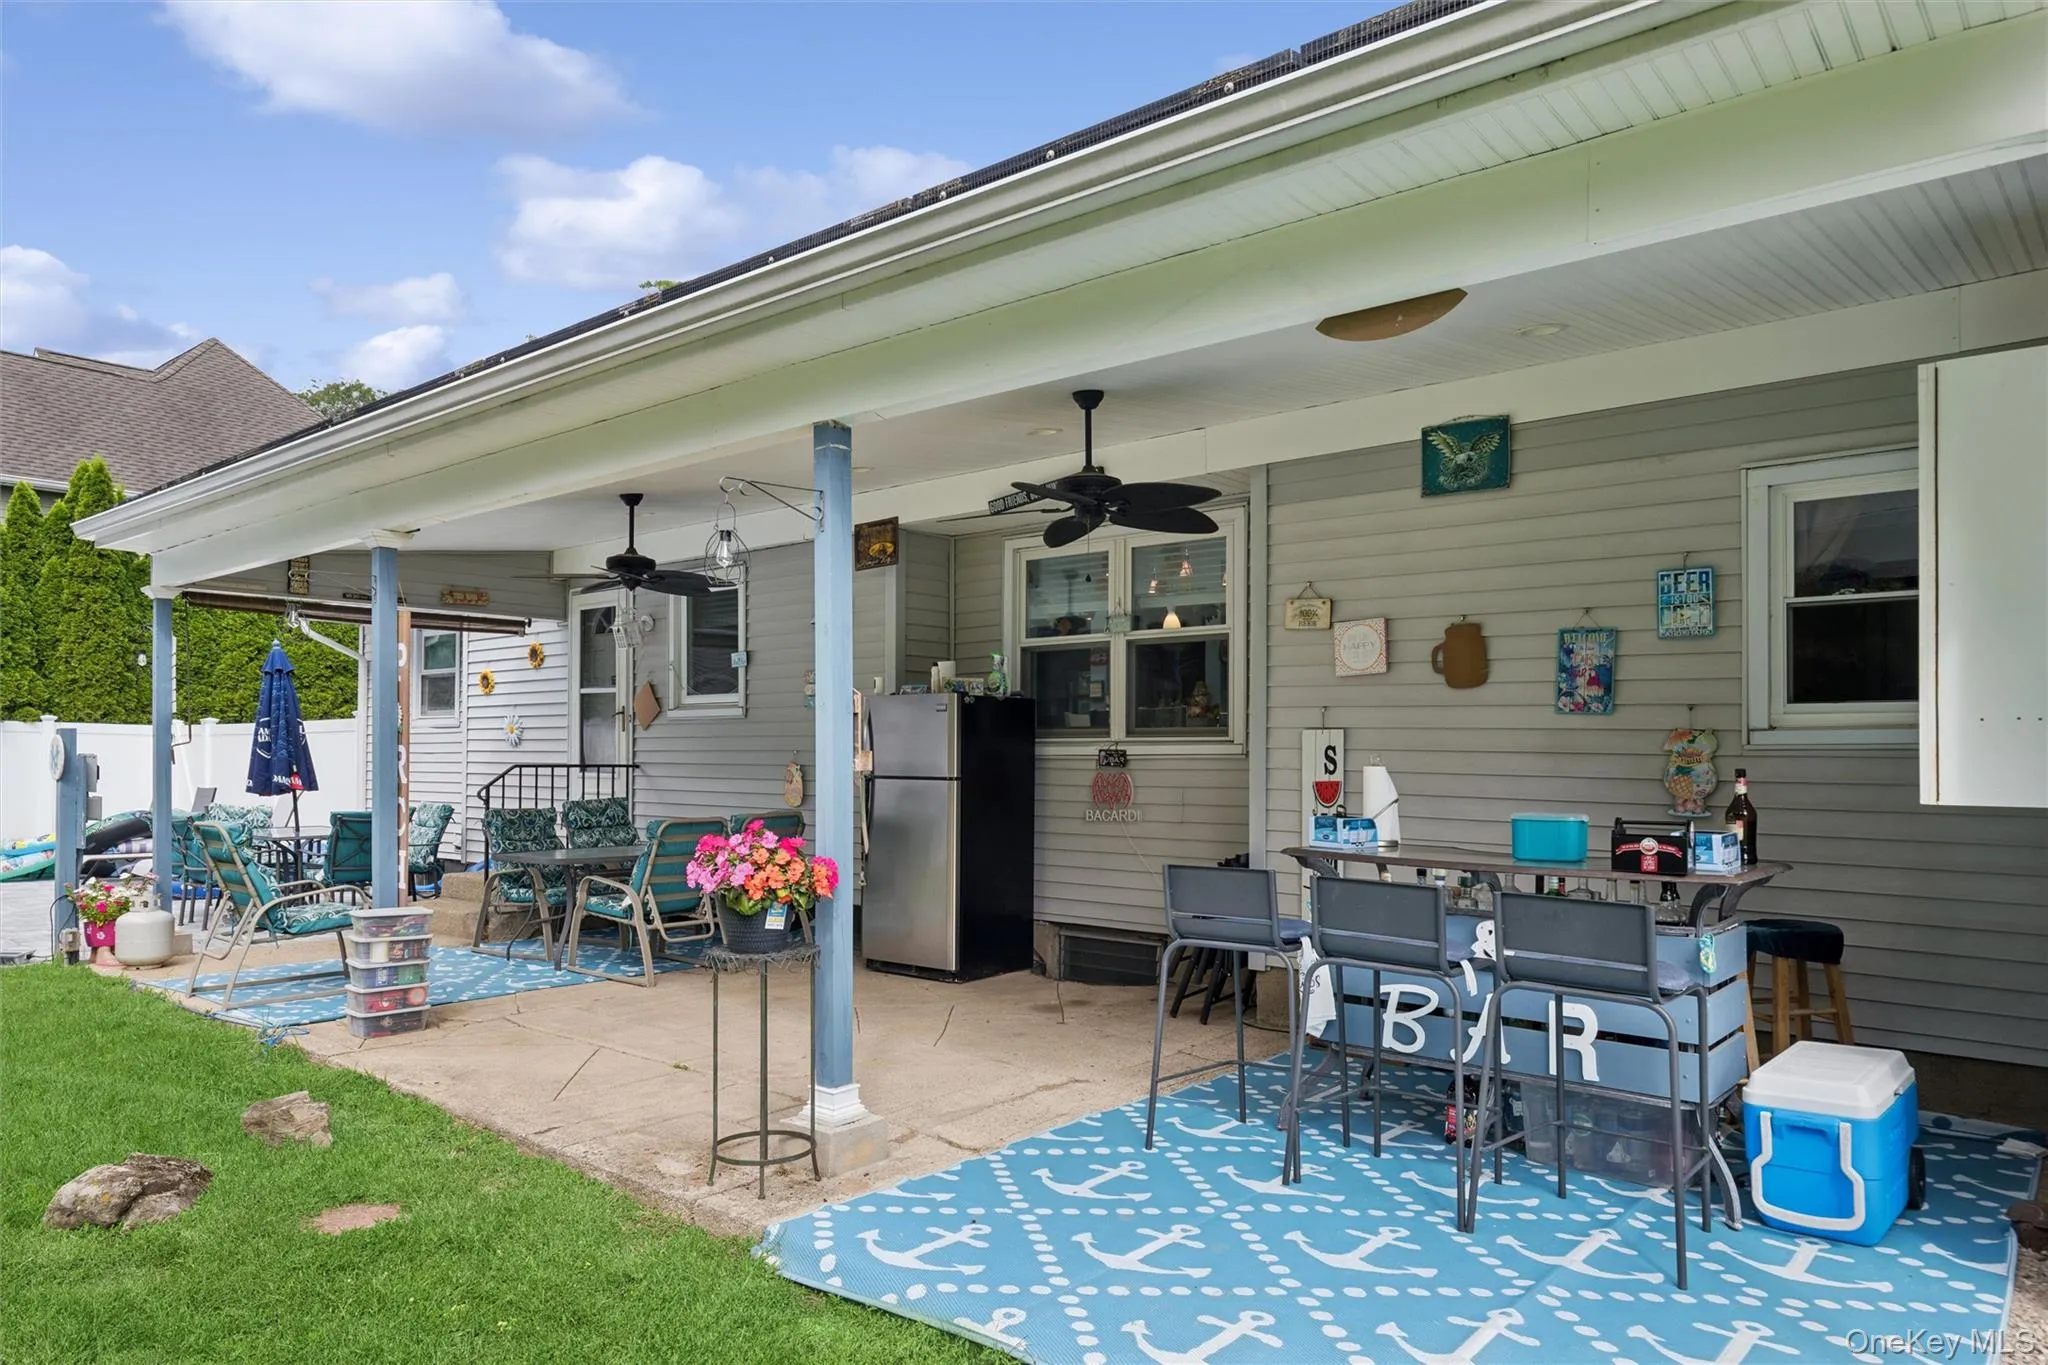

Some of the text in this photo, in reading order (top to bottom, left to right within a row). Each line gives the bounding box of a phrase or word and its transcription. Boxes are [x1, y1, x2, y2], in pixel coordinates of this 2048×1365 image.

[1660, 571, 1710, 594] BEER
[1564, 632, 1608, 643] WELCOME
[1343, 641, 1376, 651] HAPPY
[1086, 809, 1142, 822] BACARDI
